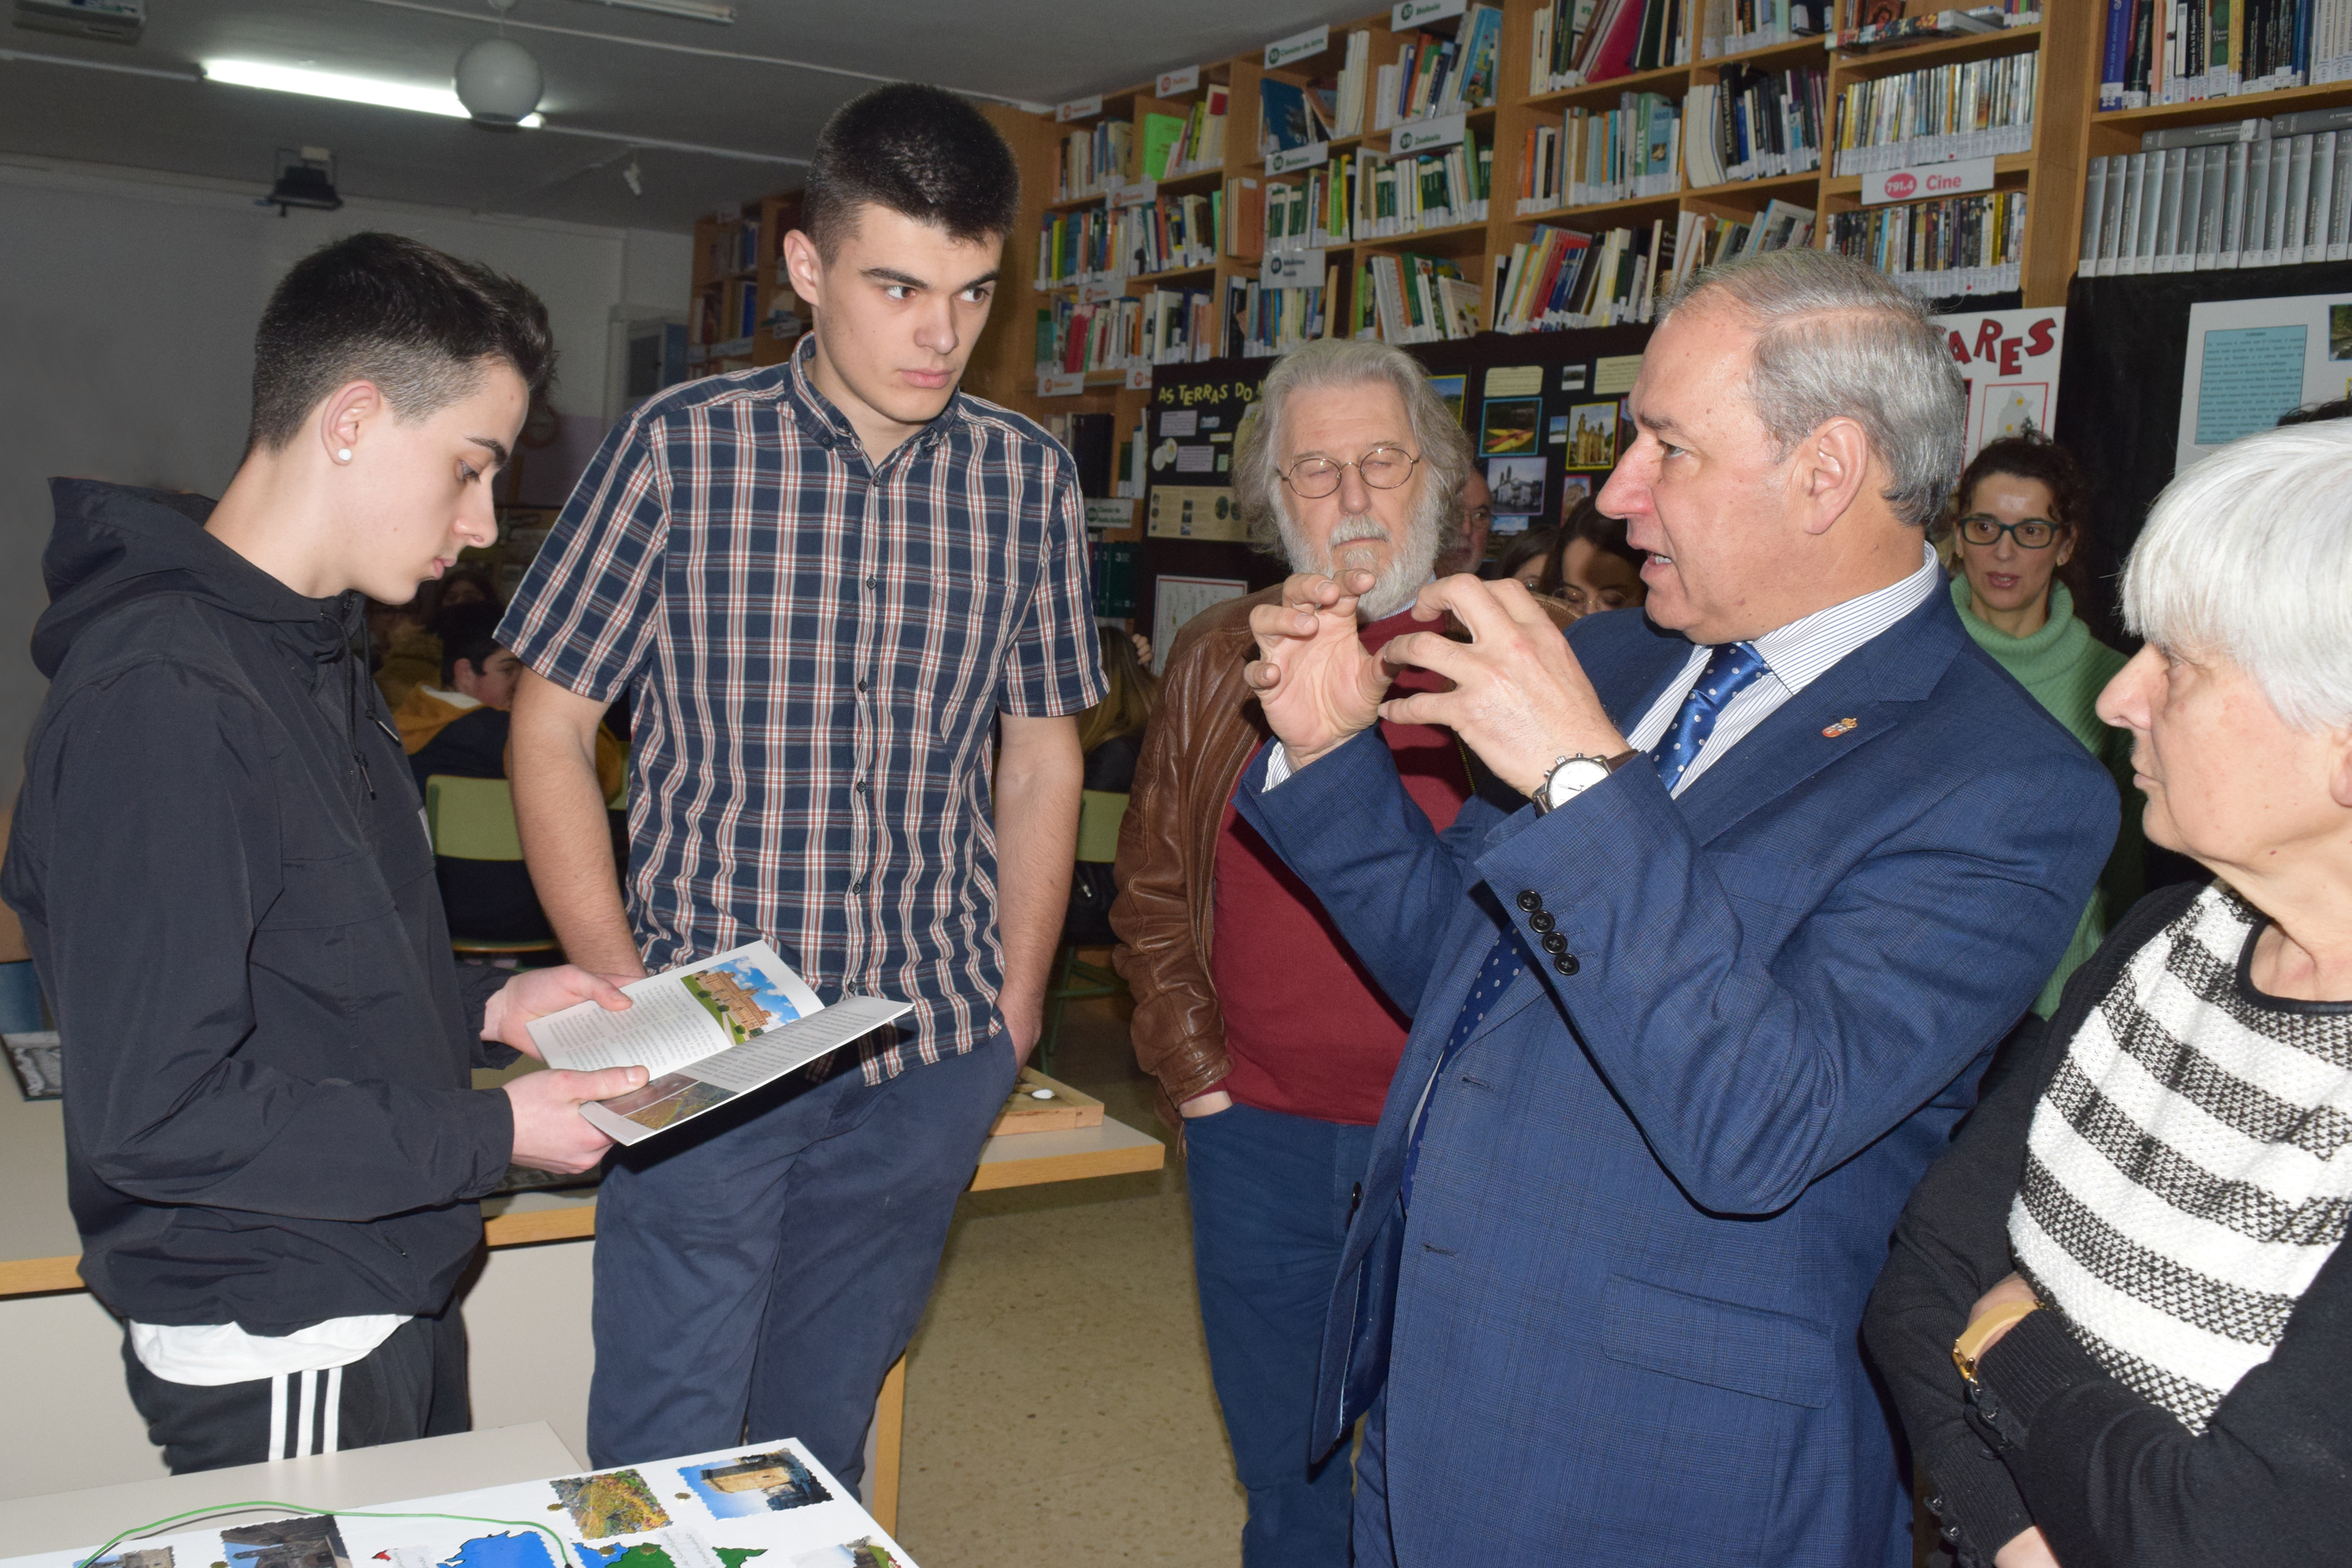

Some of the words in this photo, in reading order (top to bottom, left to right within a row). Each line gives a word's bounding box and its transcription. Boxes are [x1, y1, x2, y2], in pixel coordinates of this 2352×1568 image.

[1886, 180, 1913, 193] 791.4
[1926, 174, 1962, 190] Cine
[1936, 318, 2056, 376] ARES
[1158, 386, 1175, 405] AS
[1178, 383, 1229, 407] TERRAS
[1235, 381, 1253, 402] DO
